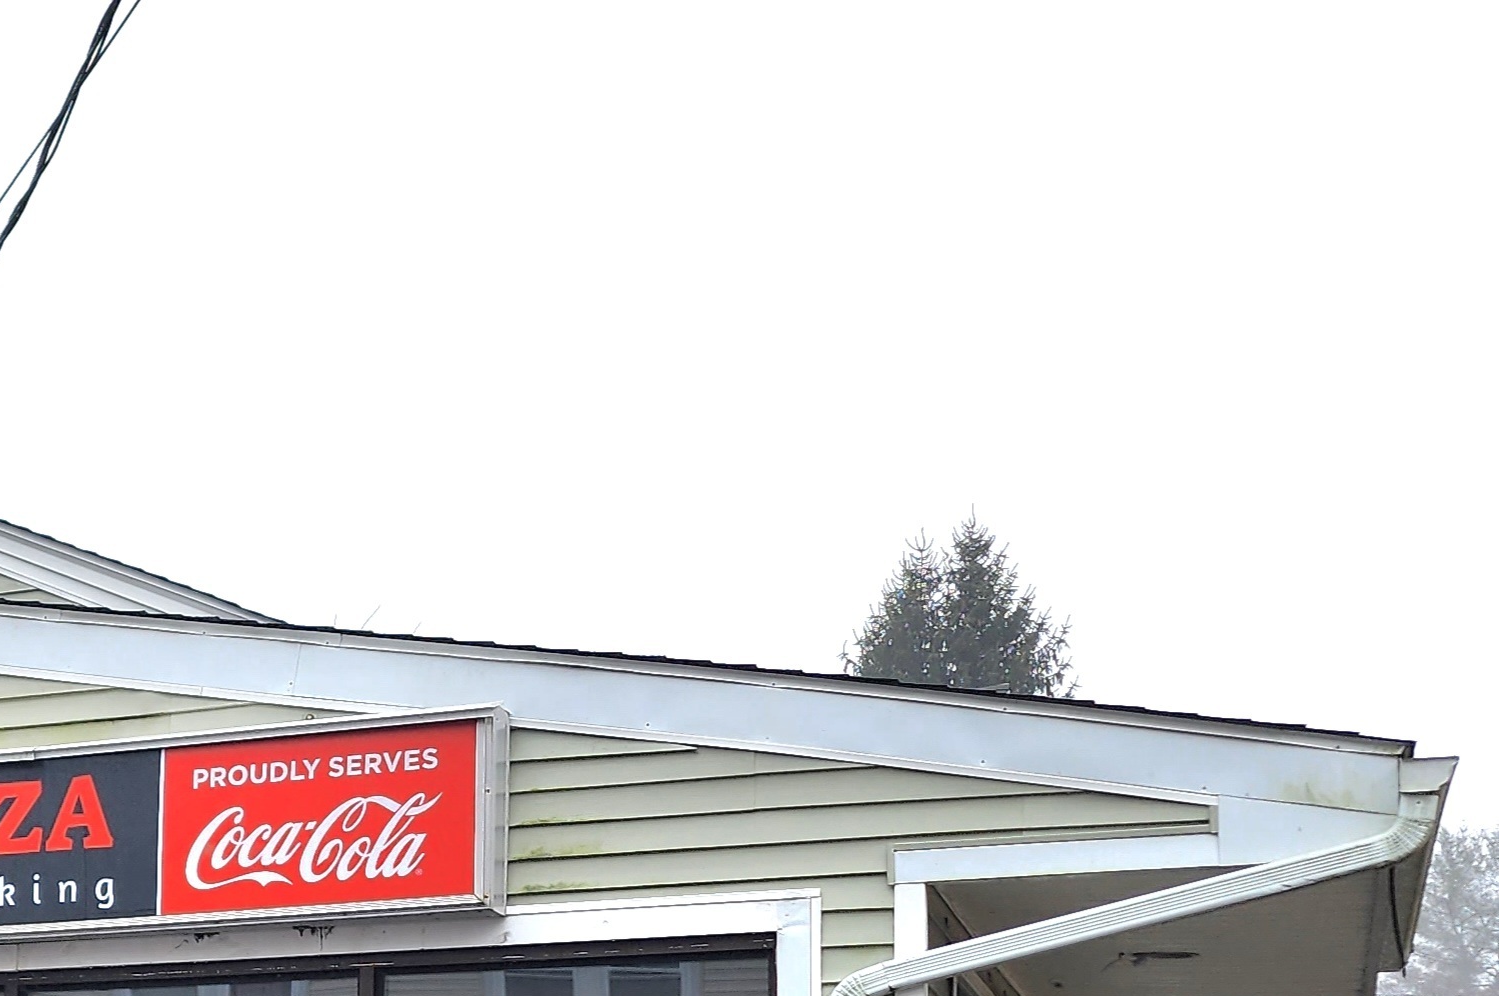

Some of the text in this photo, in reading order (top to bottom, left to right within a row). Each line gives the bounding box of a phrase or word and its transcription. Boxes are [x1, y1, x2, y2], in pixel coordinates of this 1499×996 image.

[192, 747, 439, 790] PROUDLY SERVES
[184, 791, 444, 890] Coca-Cola
